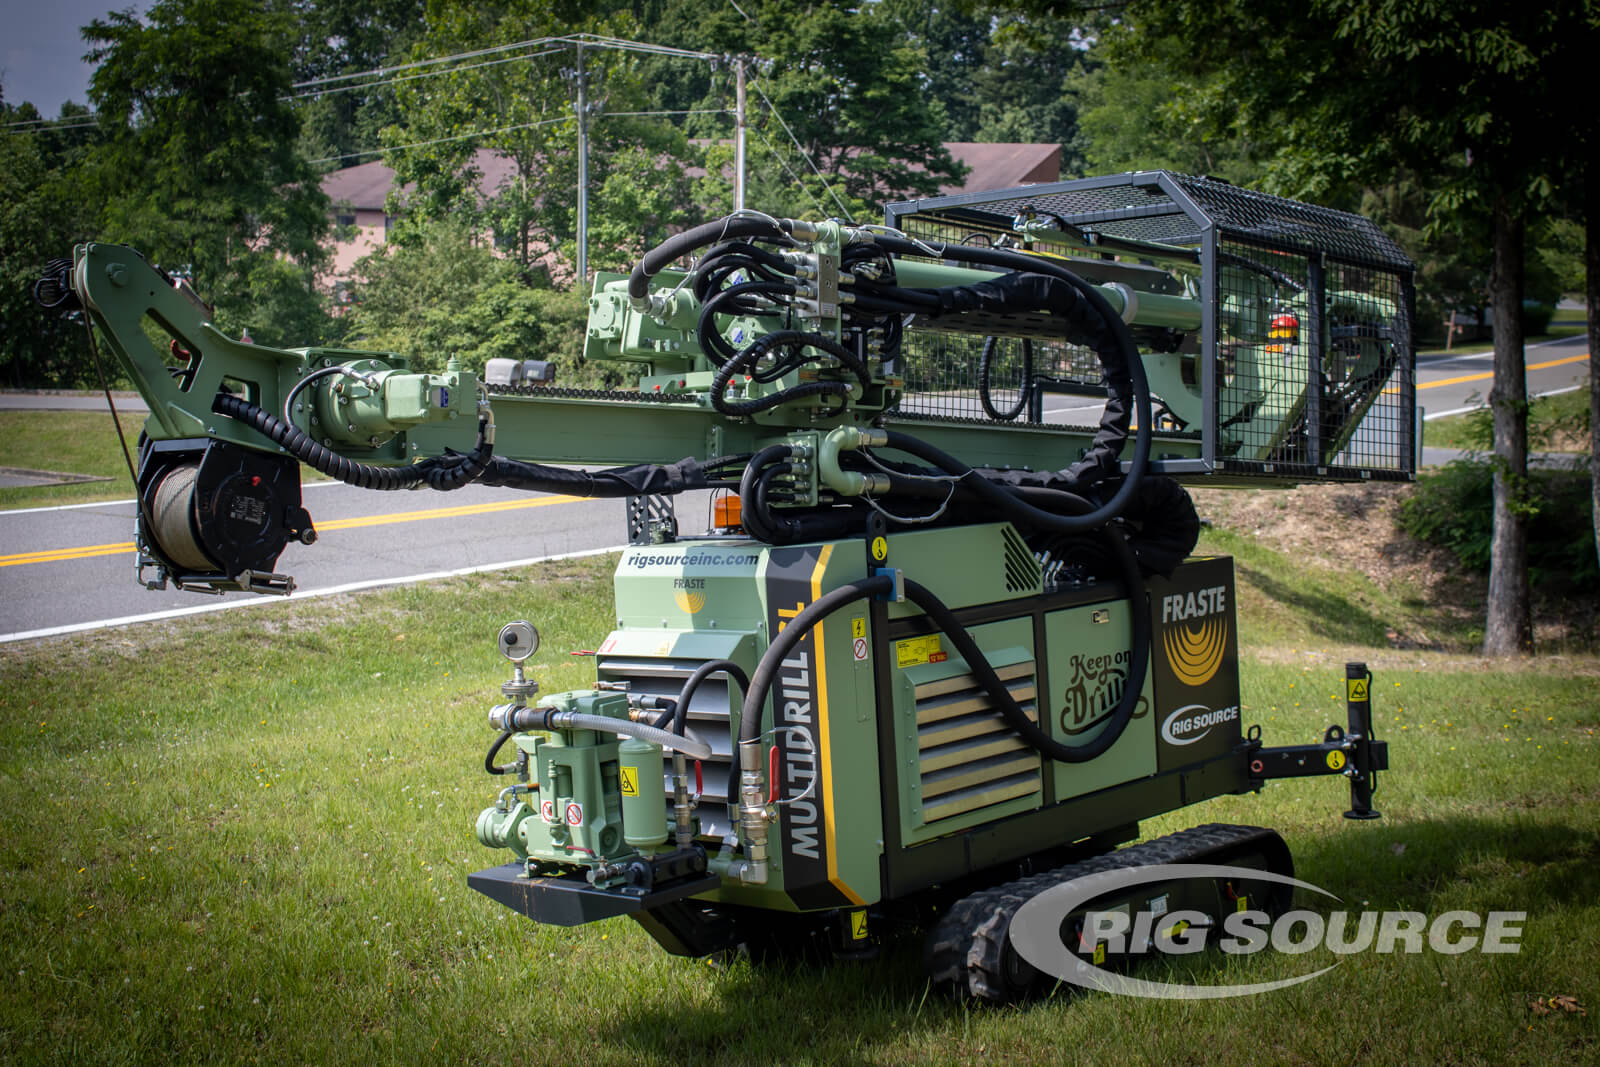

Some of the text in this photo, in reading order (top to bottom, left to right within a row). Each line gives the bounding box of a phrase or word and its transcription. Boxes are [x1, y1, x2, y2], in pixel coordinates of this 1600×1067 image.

[627, 552, 759, 569] rigsourceinc.com
[673, 578, 705, 589] FRASTE
[1162, 585, 1226, 624] FRASTE
[1070, 650, 1131, 685] Keep on
[777, 601, 820, 859] MULTIDRILL L
[1171, 706, 1239, 736] RIG SOURCE
